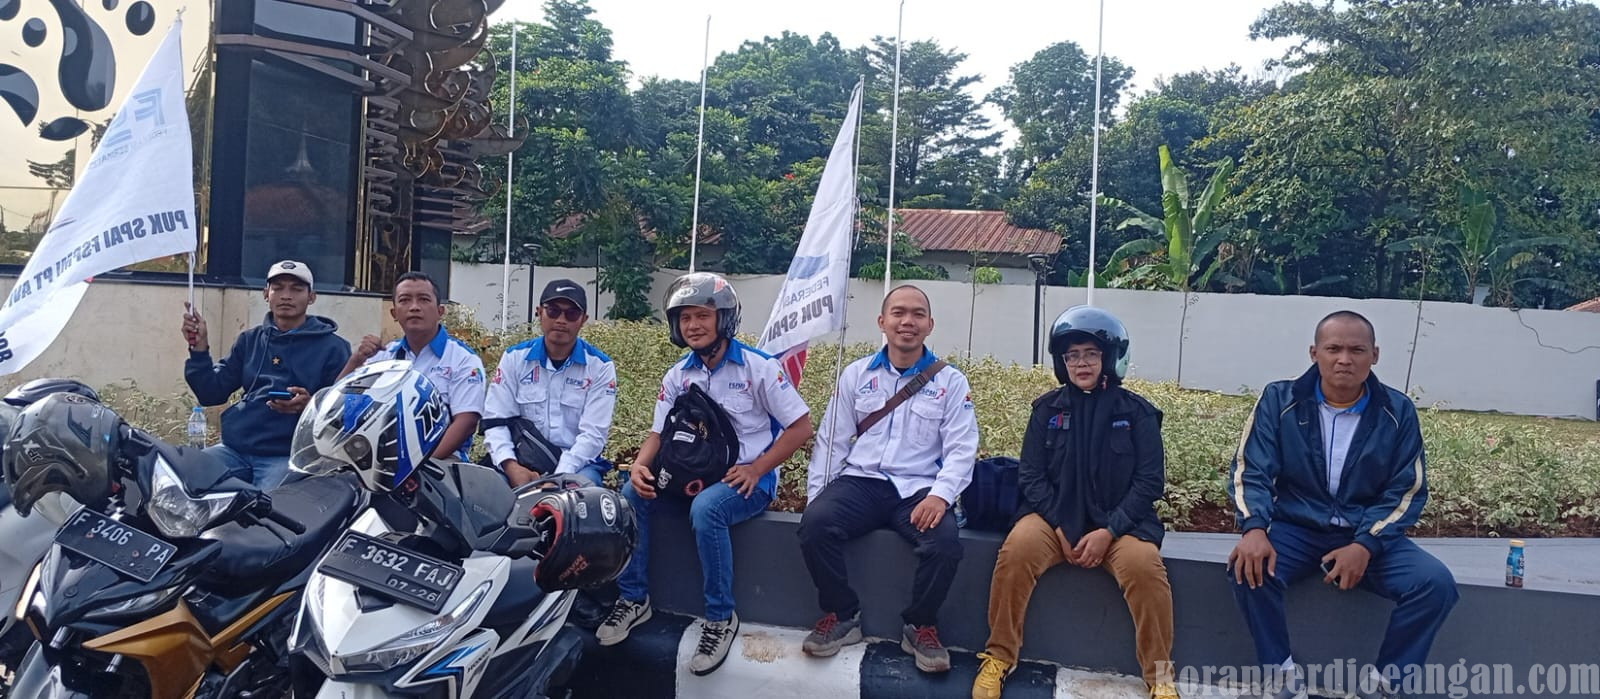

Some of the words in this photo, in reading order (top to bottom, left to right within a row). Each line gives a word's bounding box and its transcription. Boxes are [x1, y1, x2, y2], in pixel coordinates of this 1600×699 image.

[73, 512, 91, 526] F
[91, 519, 133, 545] 3406
[145, 543, 170, 563] PA
[340, 539, 358, 552] F
[361, 545, 409, 571] 3632
[413, 562, 453, 586] FAJ
